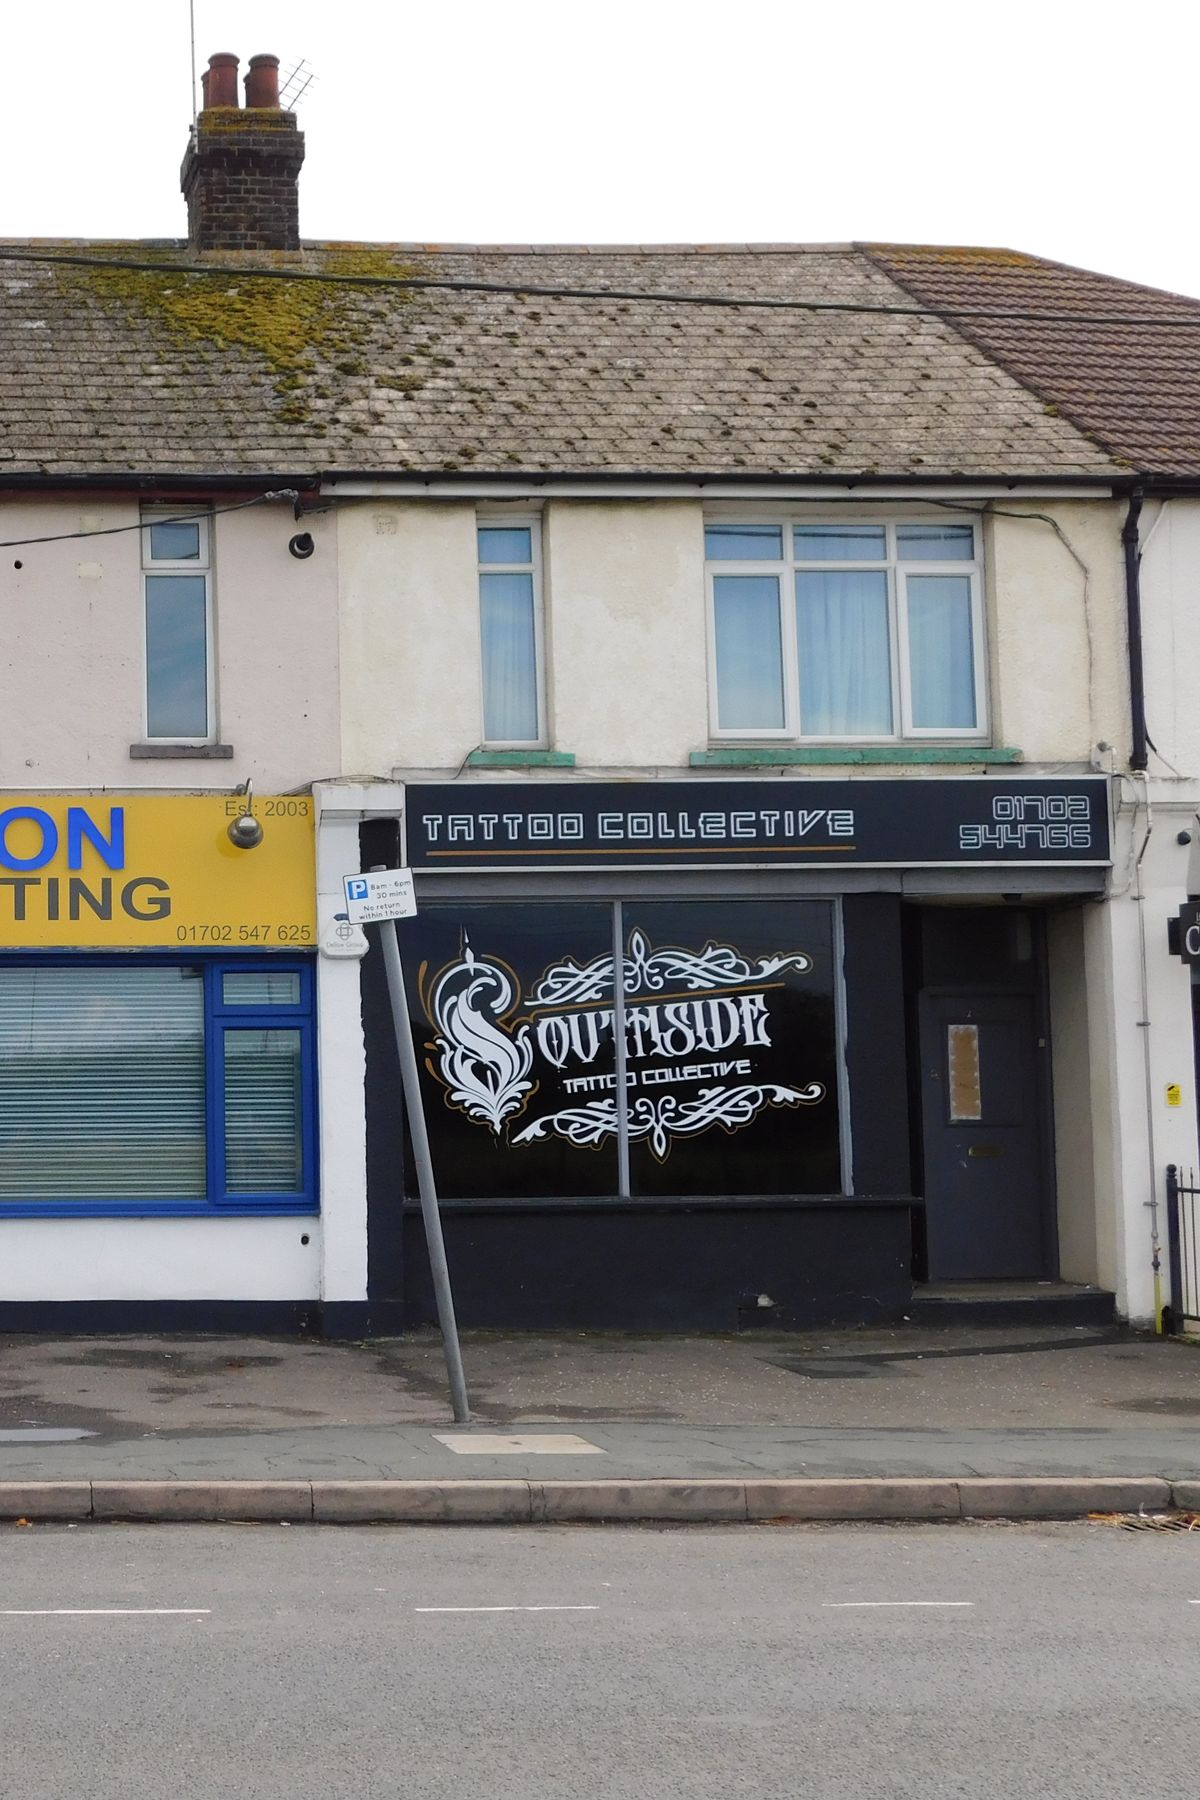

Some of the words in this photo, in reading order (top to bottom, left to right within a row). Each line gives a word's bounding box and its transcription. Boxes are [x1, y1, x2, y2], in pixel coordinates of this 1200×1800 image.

[225, 801, 258, 817] Es:
[265, 801, 309, 817] 2003
[992, 795, 1091, 821] 01702
[423, 813, 583, 841] TATTOO
[598, 809, 854, 839] COLLECTIVE
[959, 824, 1091, 849] 544766
[351, 881, 366, 899] P
[394, 880, 412, 888] 6pm
[389, 890, 408, 898] mins
[376, 902, 401, 910] return
[358, 912, 383, 920] within
[176, 925, 232, 941] 01702
[238, 925, 271, 941] 547
[277, 925, 311, 941] 625
[562, 1071, 638, 1095] TATTOO
[642, 1059, 753, 1086] COLLECTIVE
